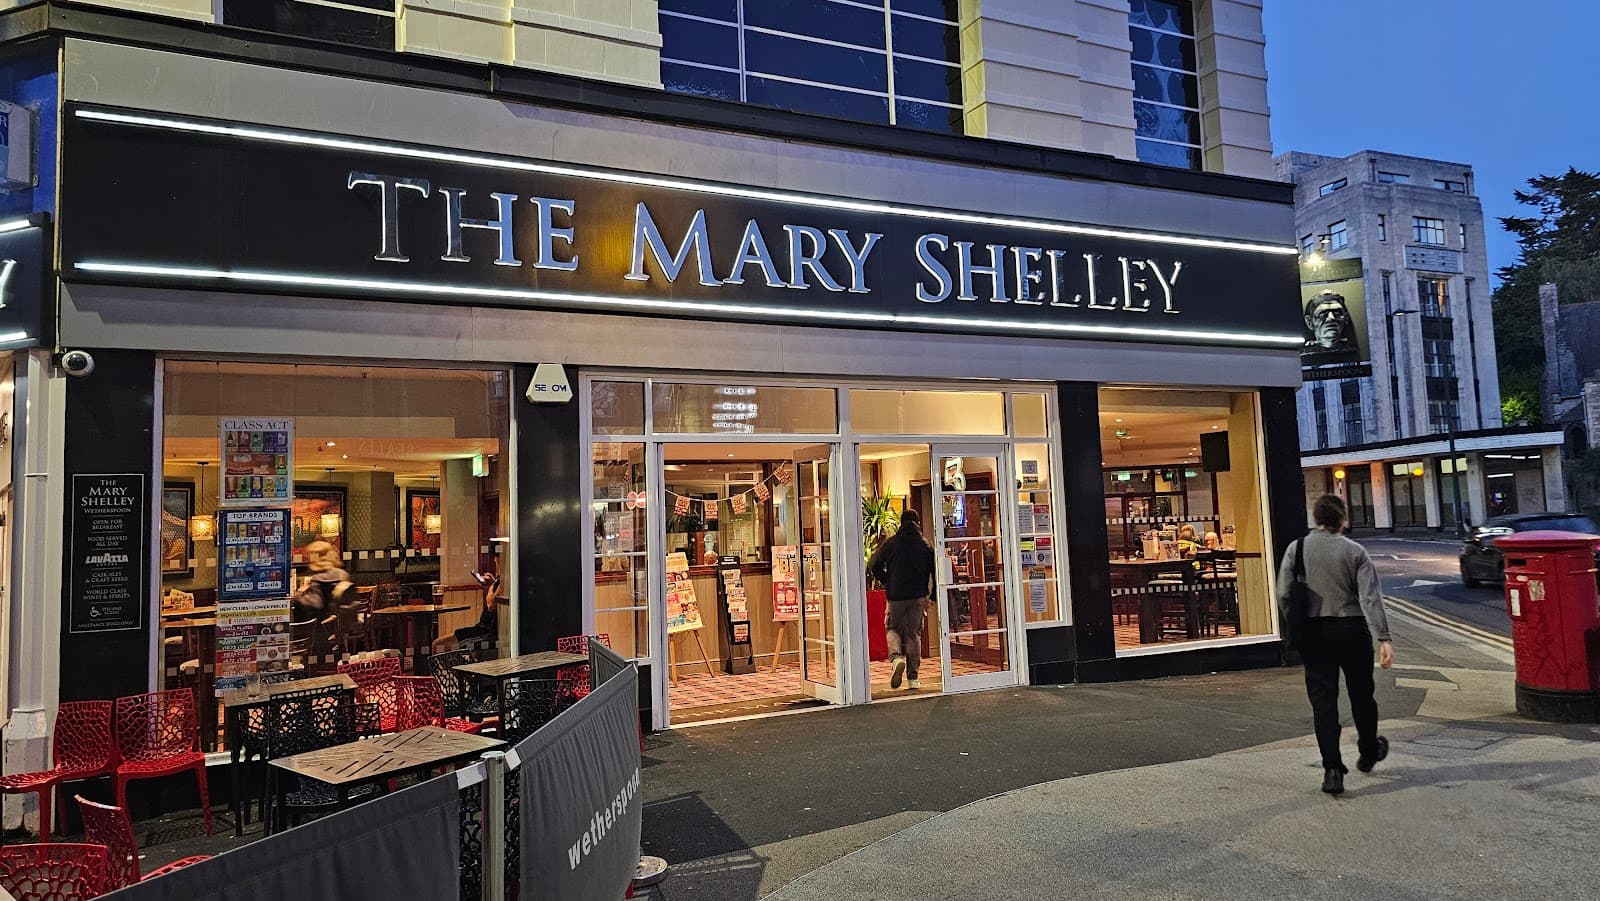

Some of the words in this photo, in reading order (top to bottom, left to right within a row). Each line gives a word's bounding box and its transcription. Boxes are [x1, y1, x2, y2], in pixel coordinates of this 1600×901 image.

[347, 170, 579, 271] THE
[624, 202, 884, 294] MARY
[915, 233, 1184, 314] SHELLEY
[224, 420, 263, 430] CLASS
[265, 420, 289, 430] ACT
[89, 487, 128, 496] MARY
[81, 496, 135, 507] SHELLEY
[85, 553, 128, 564] LAVAZZA
